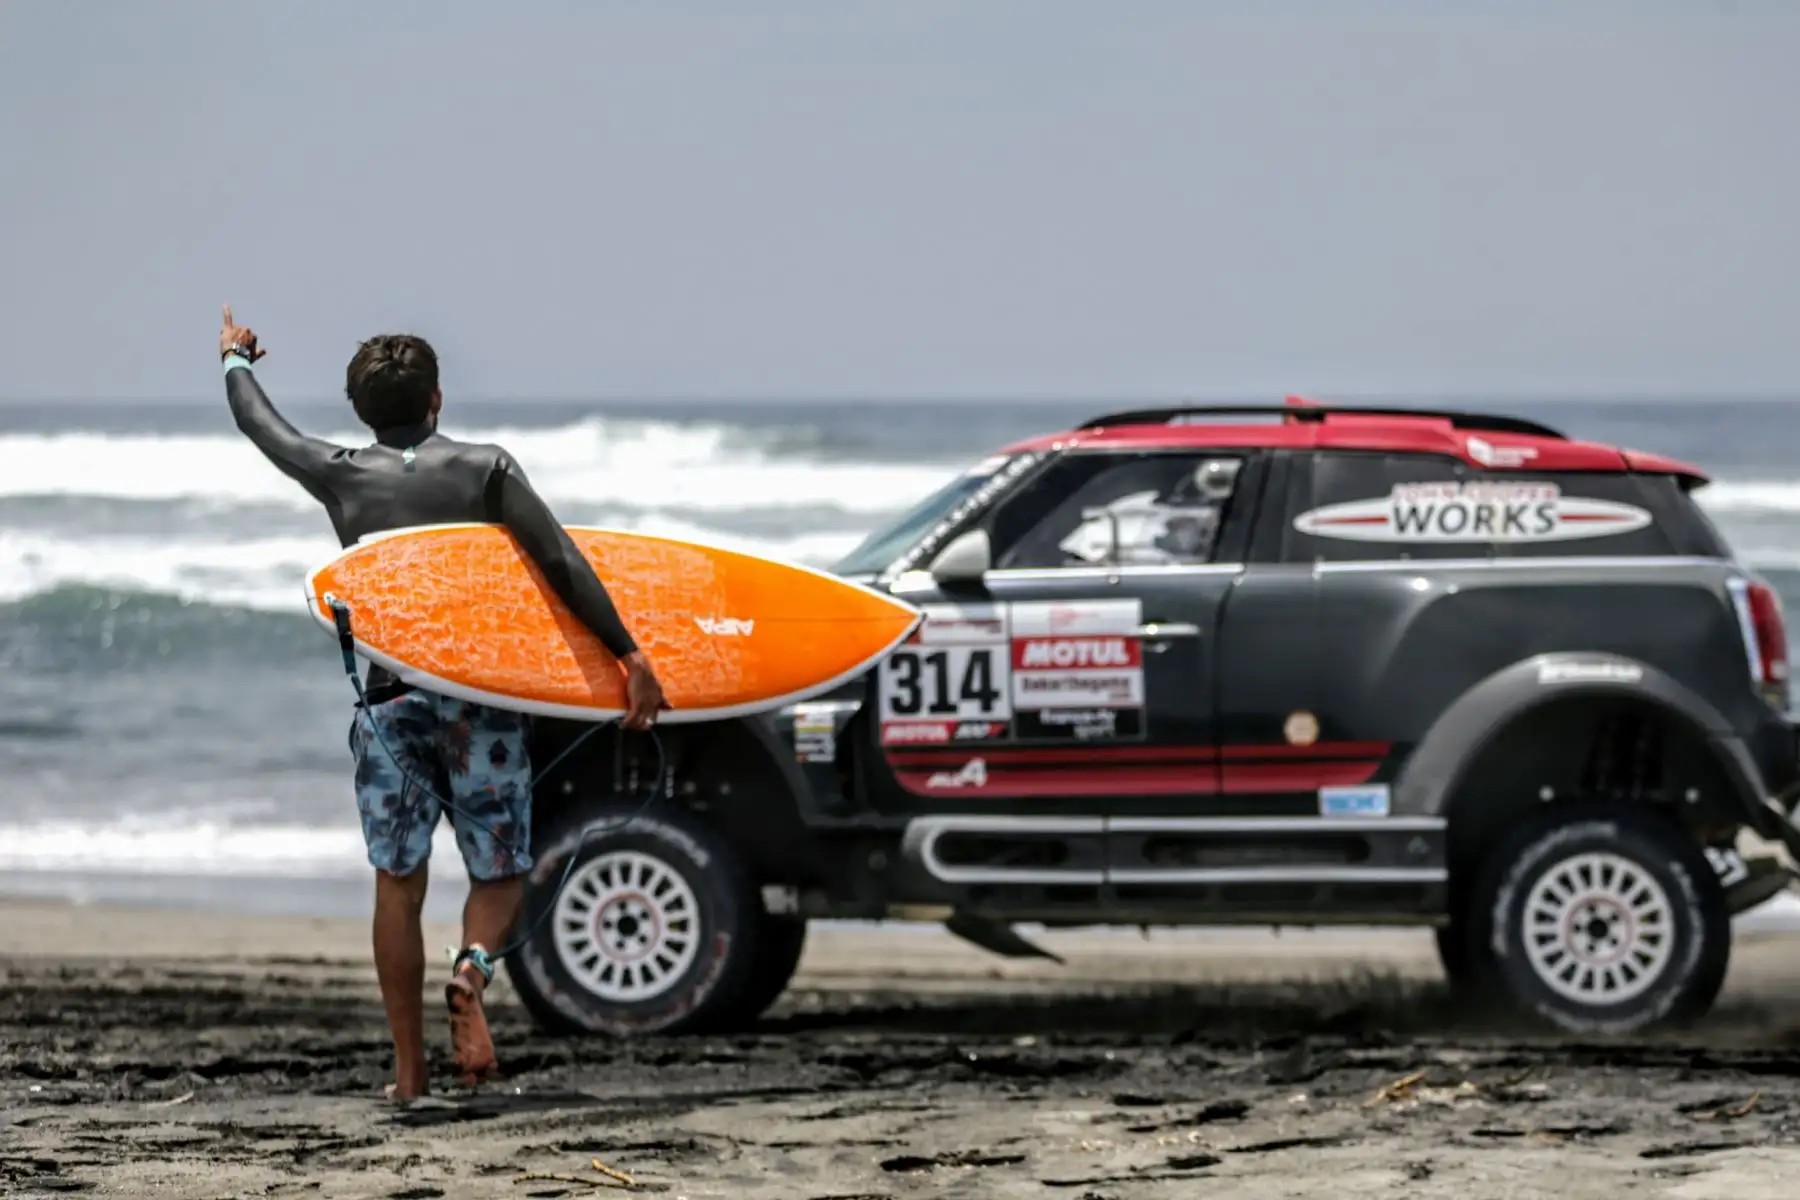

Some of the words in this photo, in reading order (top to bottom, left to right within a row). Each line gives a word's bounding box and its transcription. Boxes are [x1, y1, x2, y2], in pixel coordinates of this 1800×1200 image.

[1393, 501, 1556, 535] WORKS
[1022, 637, 1130, 668] MOTUL
[889, 650, 1000, 715] 314
